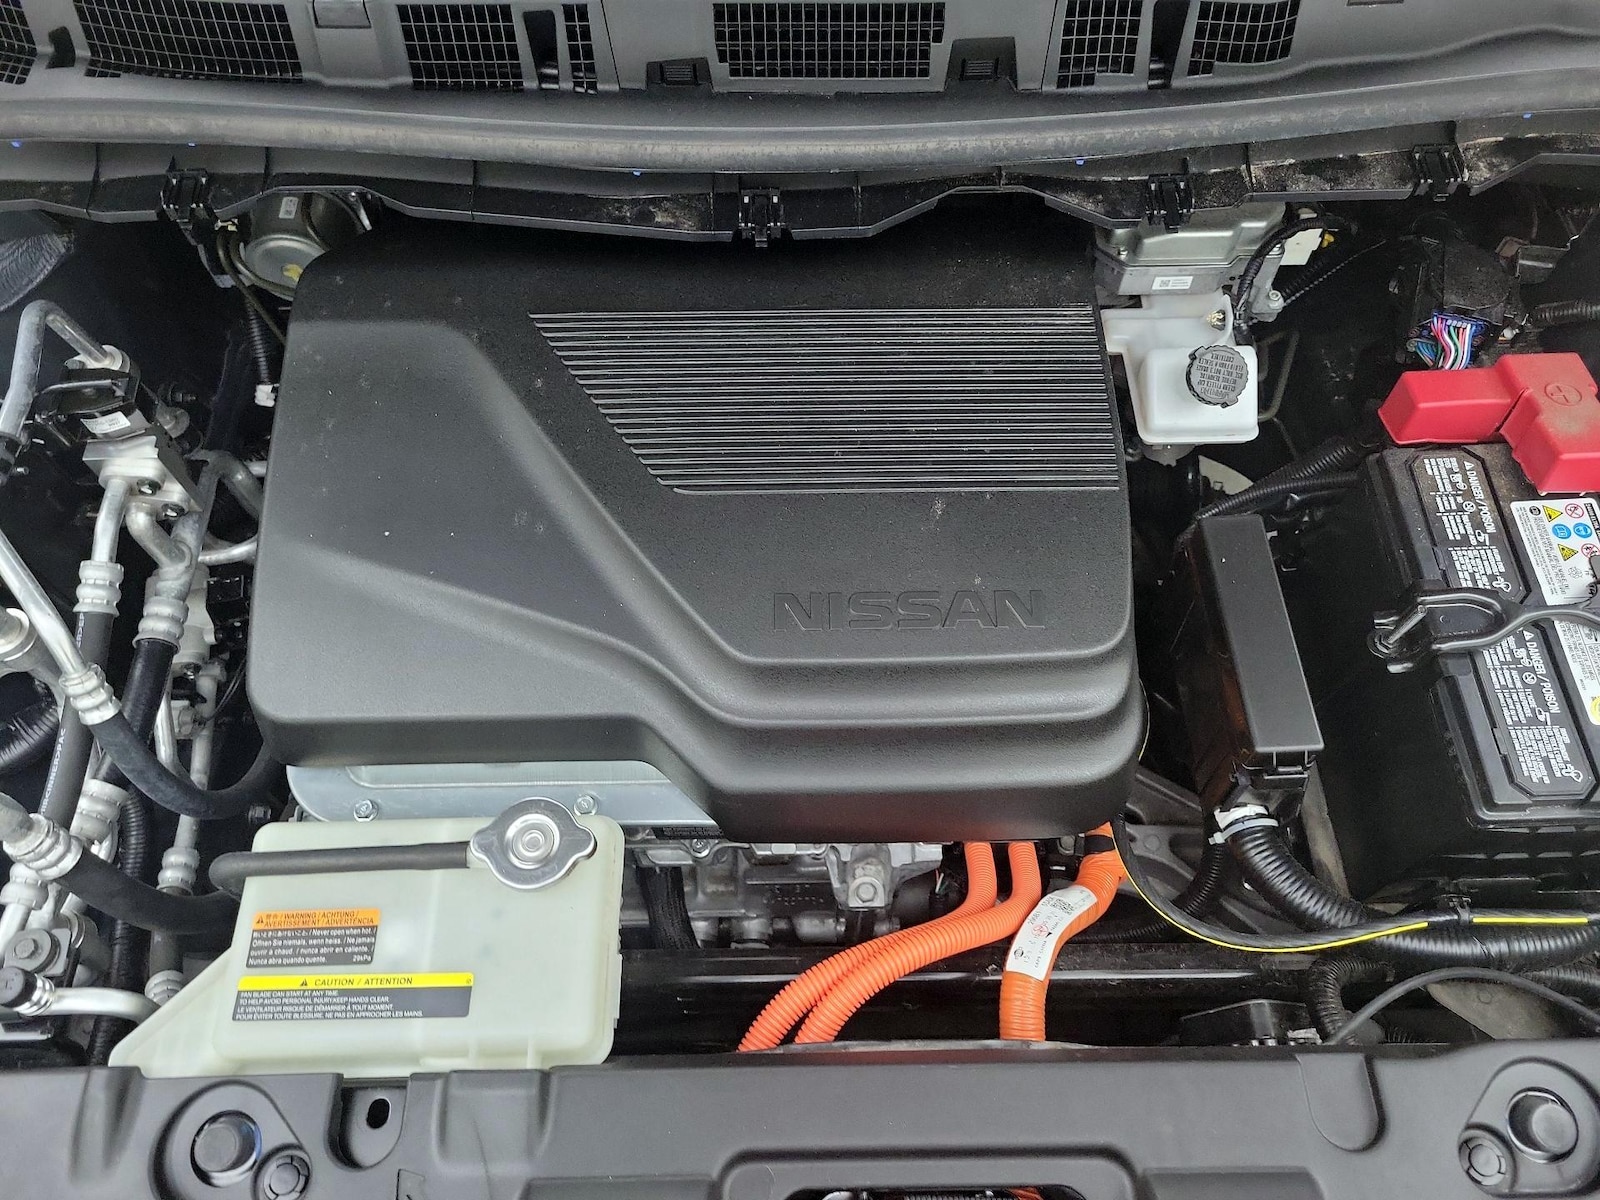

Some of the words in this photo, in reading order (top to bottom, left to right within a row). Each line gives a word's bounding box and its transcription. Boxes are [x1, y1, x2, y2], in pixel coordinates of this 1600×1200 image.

[773, 589, 1046, 632] NISSAN
[284, 911, 317, 920] WARNING
[321, 910, 355, 919] ACHTUNG
[264, 918, 320, 927] AVERTISSEMENT
[325, 916, 374, 926] ADVERTENCIA
[312, 928, 330, 936] Never
[330, 929, 345, 938] open
[345, 927, 361, 935] when
[361, 926, 373, 935] hot.
[272, 938, 282, 946] Sie
[346, 936, 355, 945] Ne
[354, 936, 375, 945] jamais
[250, 949, 267, 957] ouvrir
[300, 947, 318, 955] nunca
[319, 945, 334, 954] abrir
[248, 957, 268, 965] Nunca
[268, 957, 282, 965] abra
[282, 956, 305, 966] quando
[314, 978, 354, 987] CAUTION
[364, 976, 413, 986] ATTENTION
[239, 998, 247, 1006] TO
[248, 998, 263, 1006] HELP
[282, 997, 311, 1005] PERSONAL
